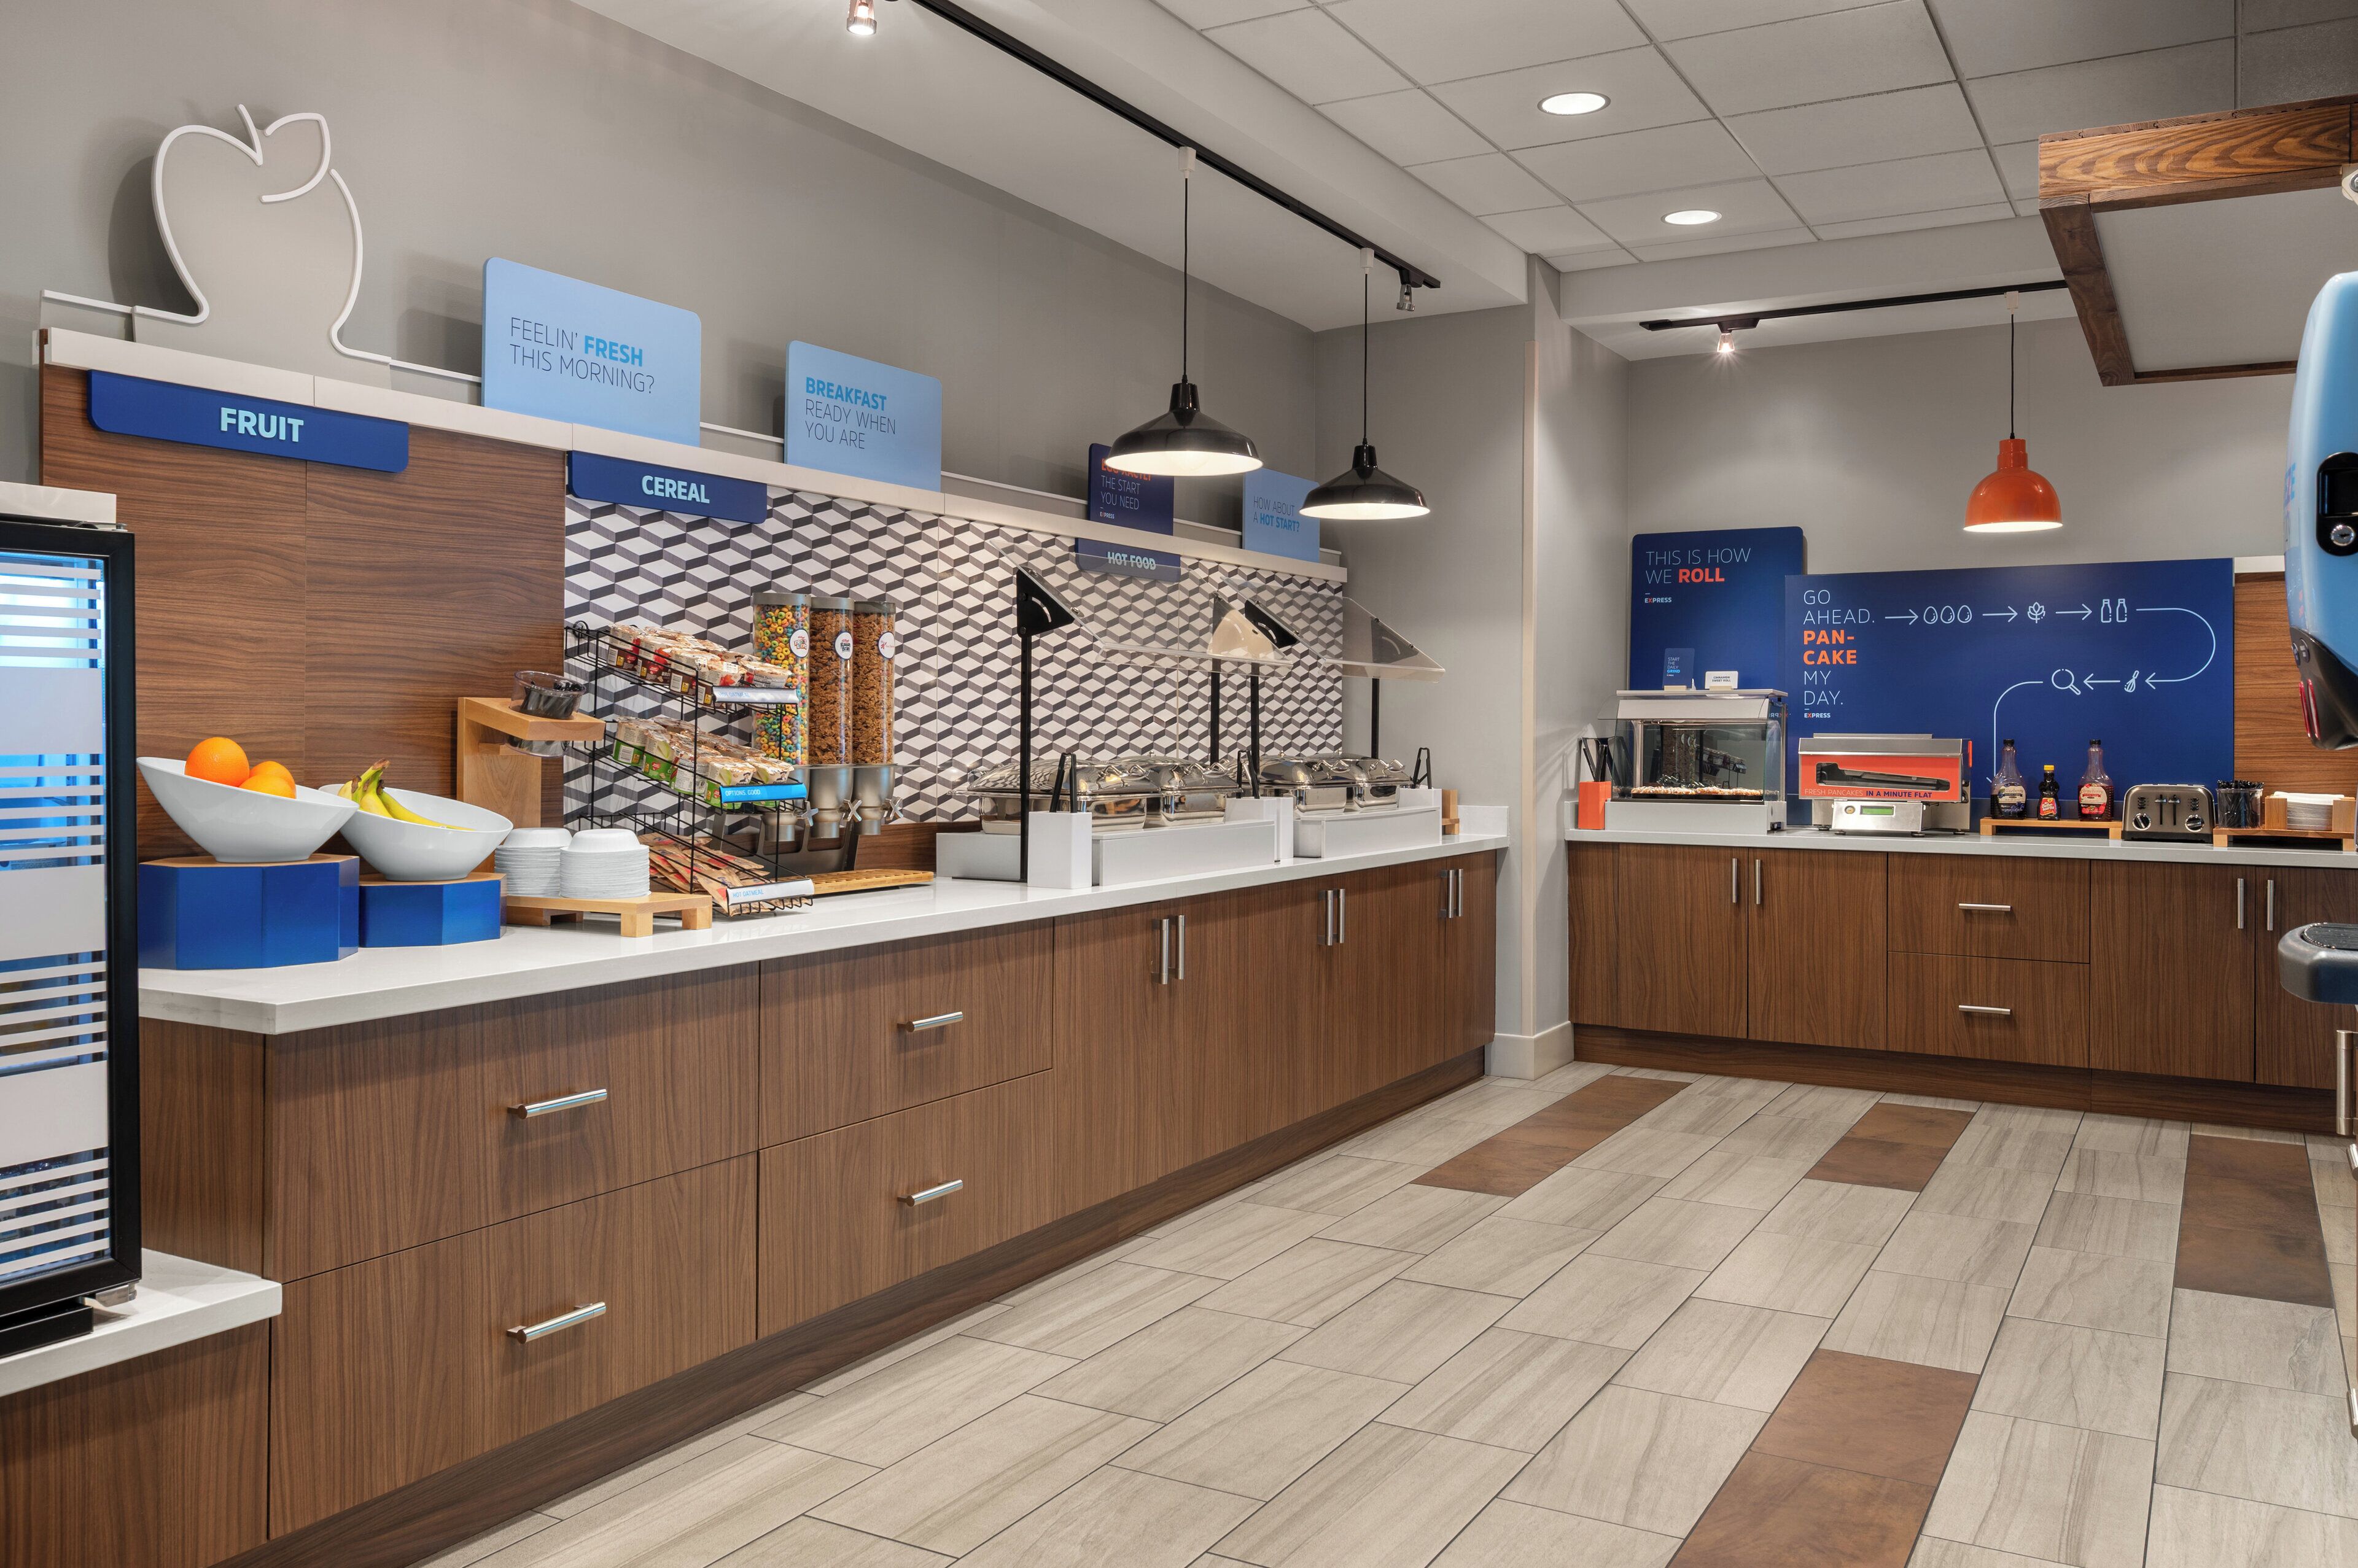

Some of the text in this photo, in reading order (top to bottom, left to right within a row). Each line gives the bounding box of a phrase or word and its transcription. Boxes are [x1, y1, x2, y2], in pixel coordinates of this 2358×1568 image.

[585, 335, 643, 367] FRESH
[510, 344, 655, 394] THIS MORNING?
[806, 377, 887, 411] BREAKFAST
[220, 407, 304, 442] FRUIT
[806, 399, 895, 435] READY WHEN
[805, 421, 865, 449] YOU ARE
[642, 475, 710, 503] CEREAL
[1101, 475, 1140, 495] THE START
[1101, 491, 1139, 510] YOU NEED
[1253, 496, 1295, 516] HOW ABOUT
[1100, 511, 1115, 519] EXPRESS
[1253, 511, 1300, 532] A HOT START?
[1107, 551, 1156, 570] HOT FOOD
[1646, 548, 1751, 565] THIS IS HOW
[1646, 568, 1725, 584] WE ROLL
[1804, 589, 1831, 605] GO
[1803, 608, 1875, 624] AHEAD.
[1804, 629, 1854, 645] PAN-
[1803, 650, 1857, 665] CAKE
[1804, 670, 1831, 685] MY
[1804, 691, 1843, 705] DAY.
